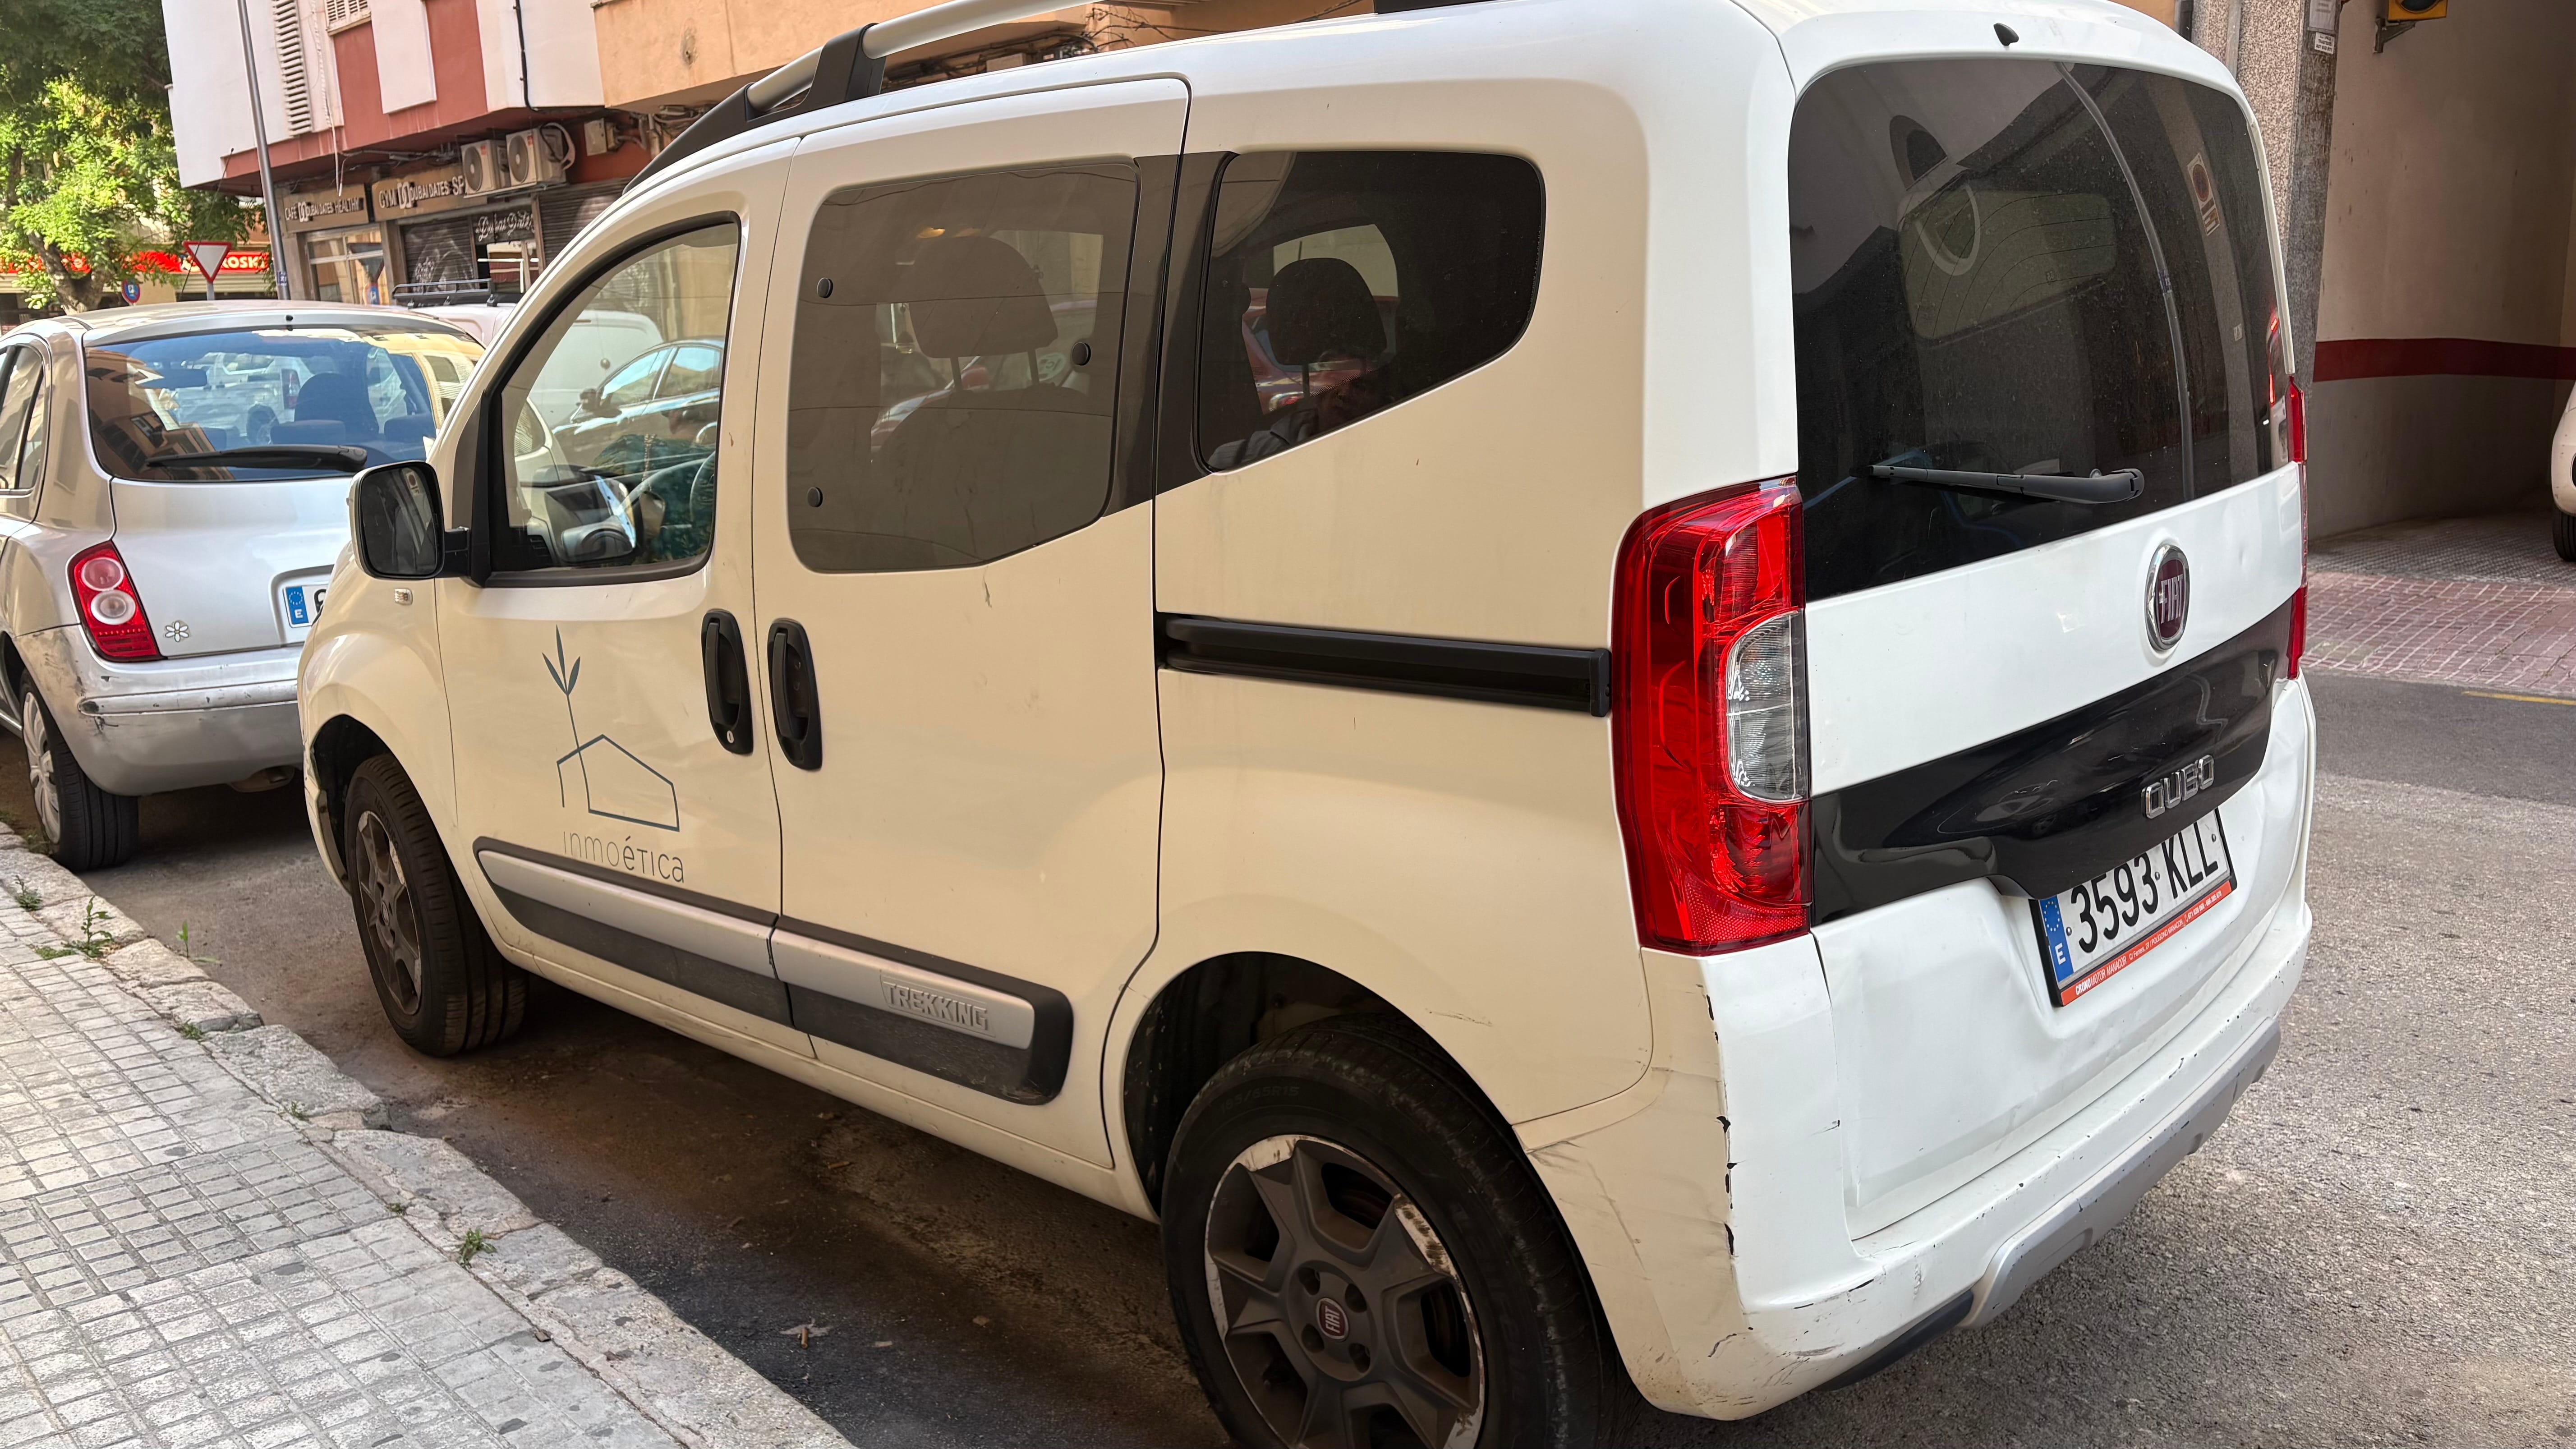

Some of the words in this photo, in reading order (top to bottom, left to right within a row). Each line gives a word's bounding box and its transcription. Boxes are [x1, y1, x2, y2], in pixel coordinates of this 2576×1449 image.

[334, 197, 359, 214] HEALTHY
[379, 189, 397, 208] GYM
[428, 180, 450, 197] DATES
[452, 175, 464, 195] SP
[294, 609, 303, 618] E
[2159, 574, 2185, 624] FIAT
[2070, 852, 2159, 953] 3593
[2162, 821, 2218, 900] KLL
[2055, 943, 2066, 965] E
[883, 981, 988, 1030] TREKKING
[1325, 1306, 1340, 1334] FIAT
